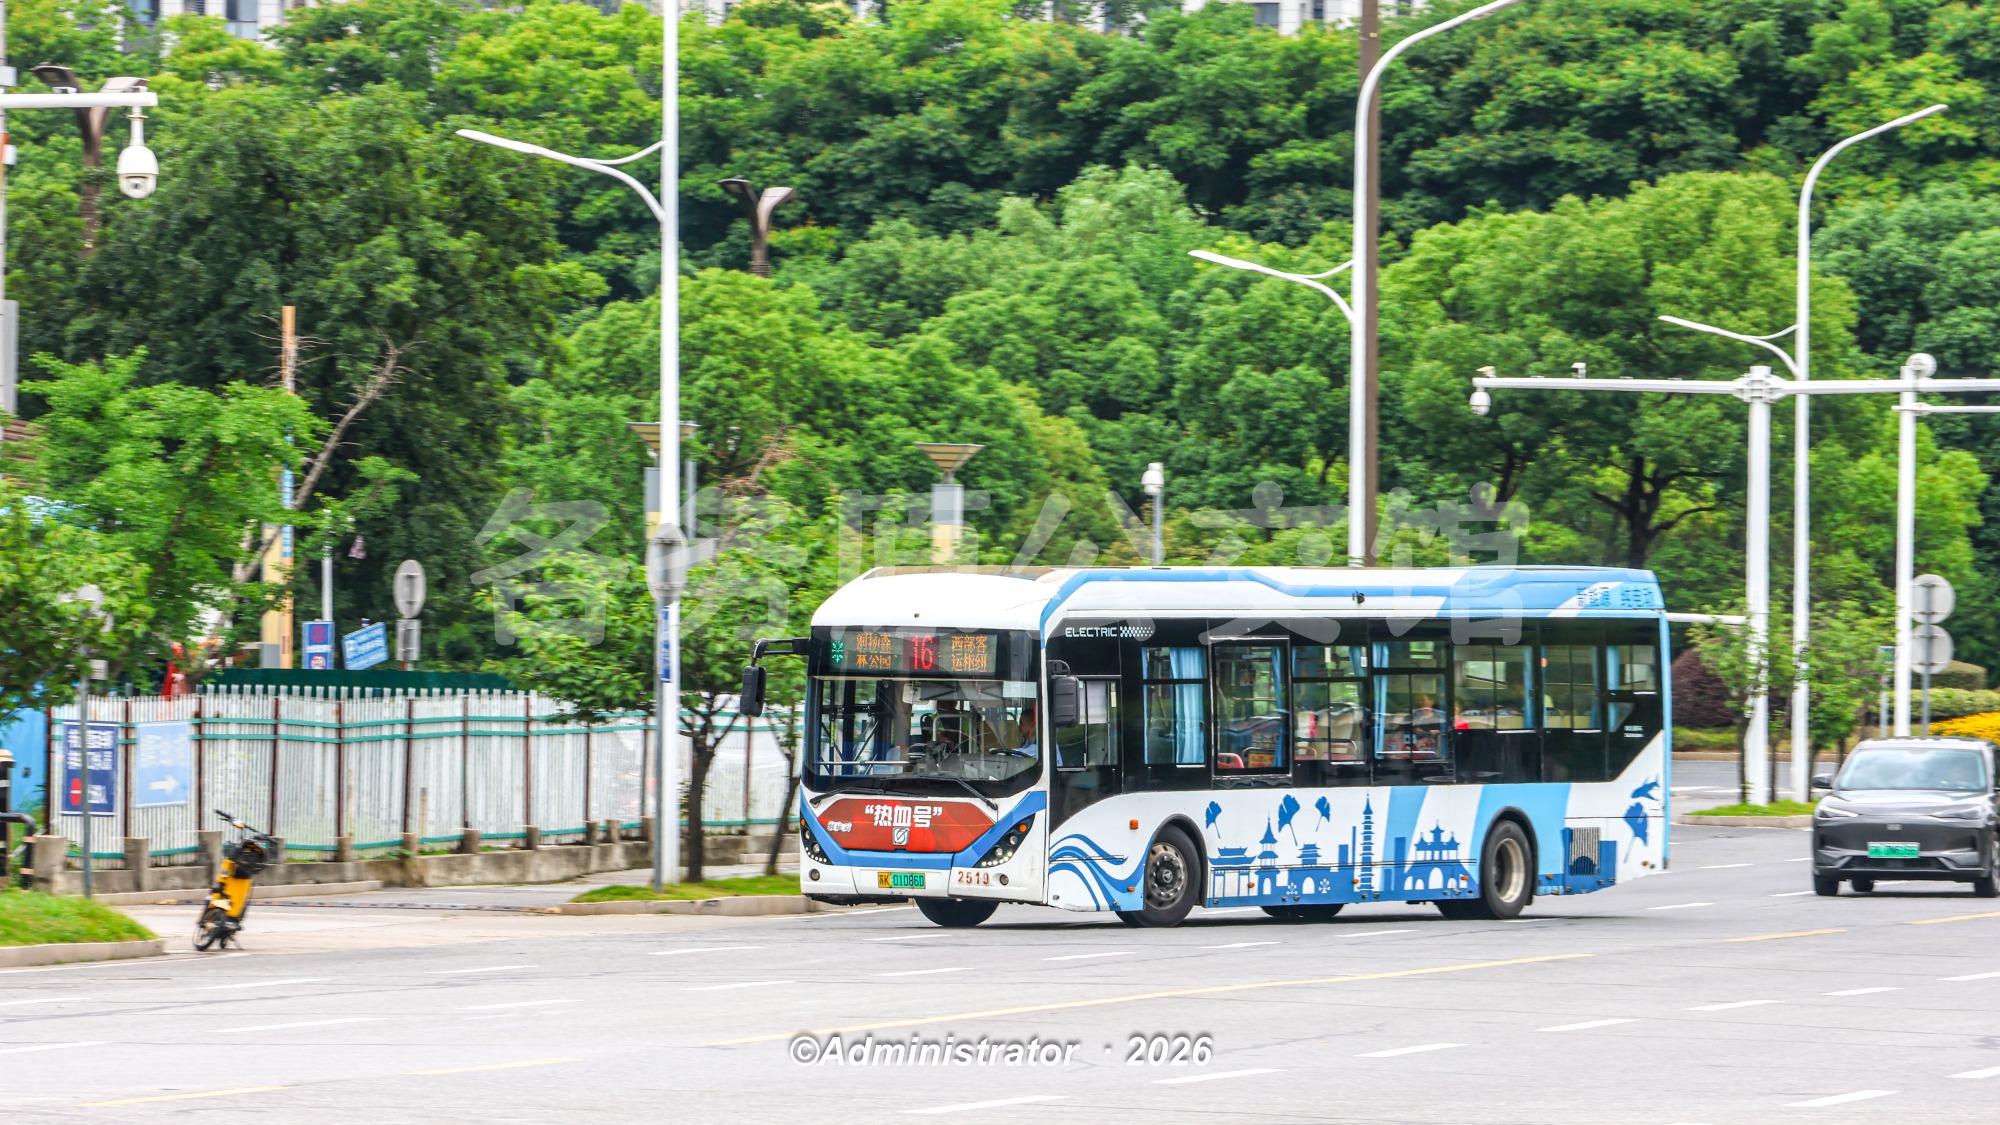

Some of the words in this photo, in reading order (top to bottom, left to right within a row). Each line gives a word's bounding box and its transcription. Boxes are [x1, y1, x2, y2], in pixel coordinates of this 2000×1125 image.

[1065, 626, 1118, 638] ELECTRIC
[951, 635, 988, 653] 西部客
[911, 634, 935, 671] 16
[958, 870, 990, 885] 2519
